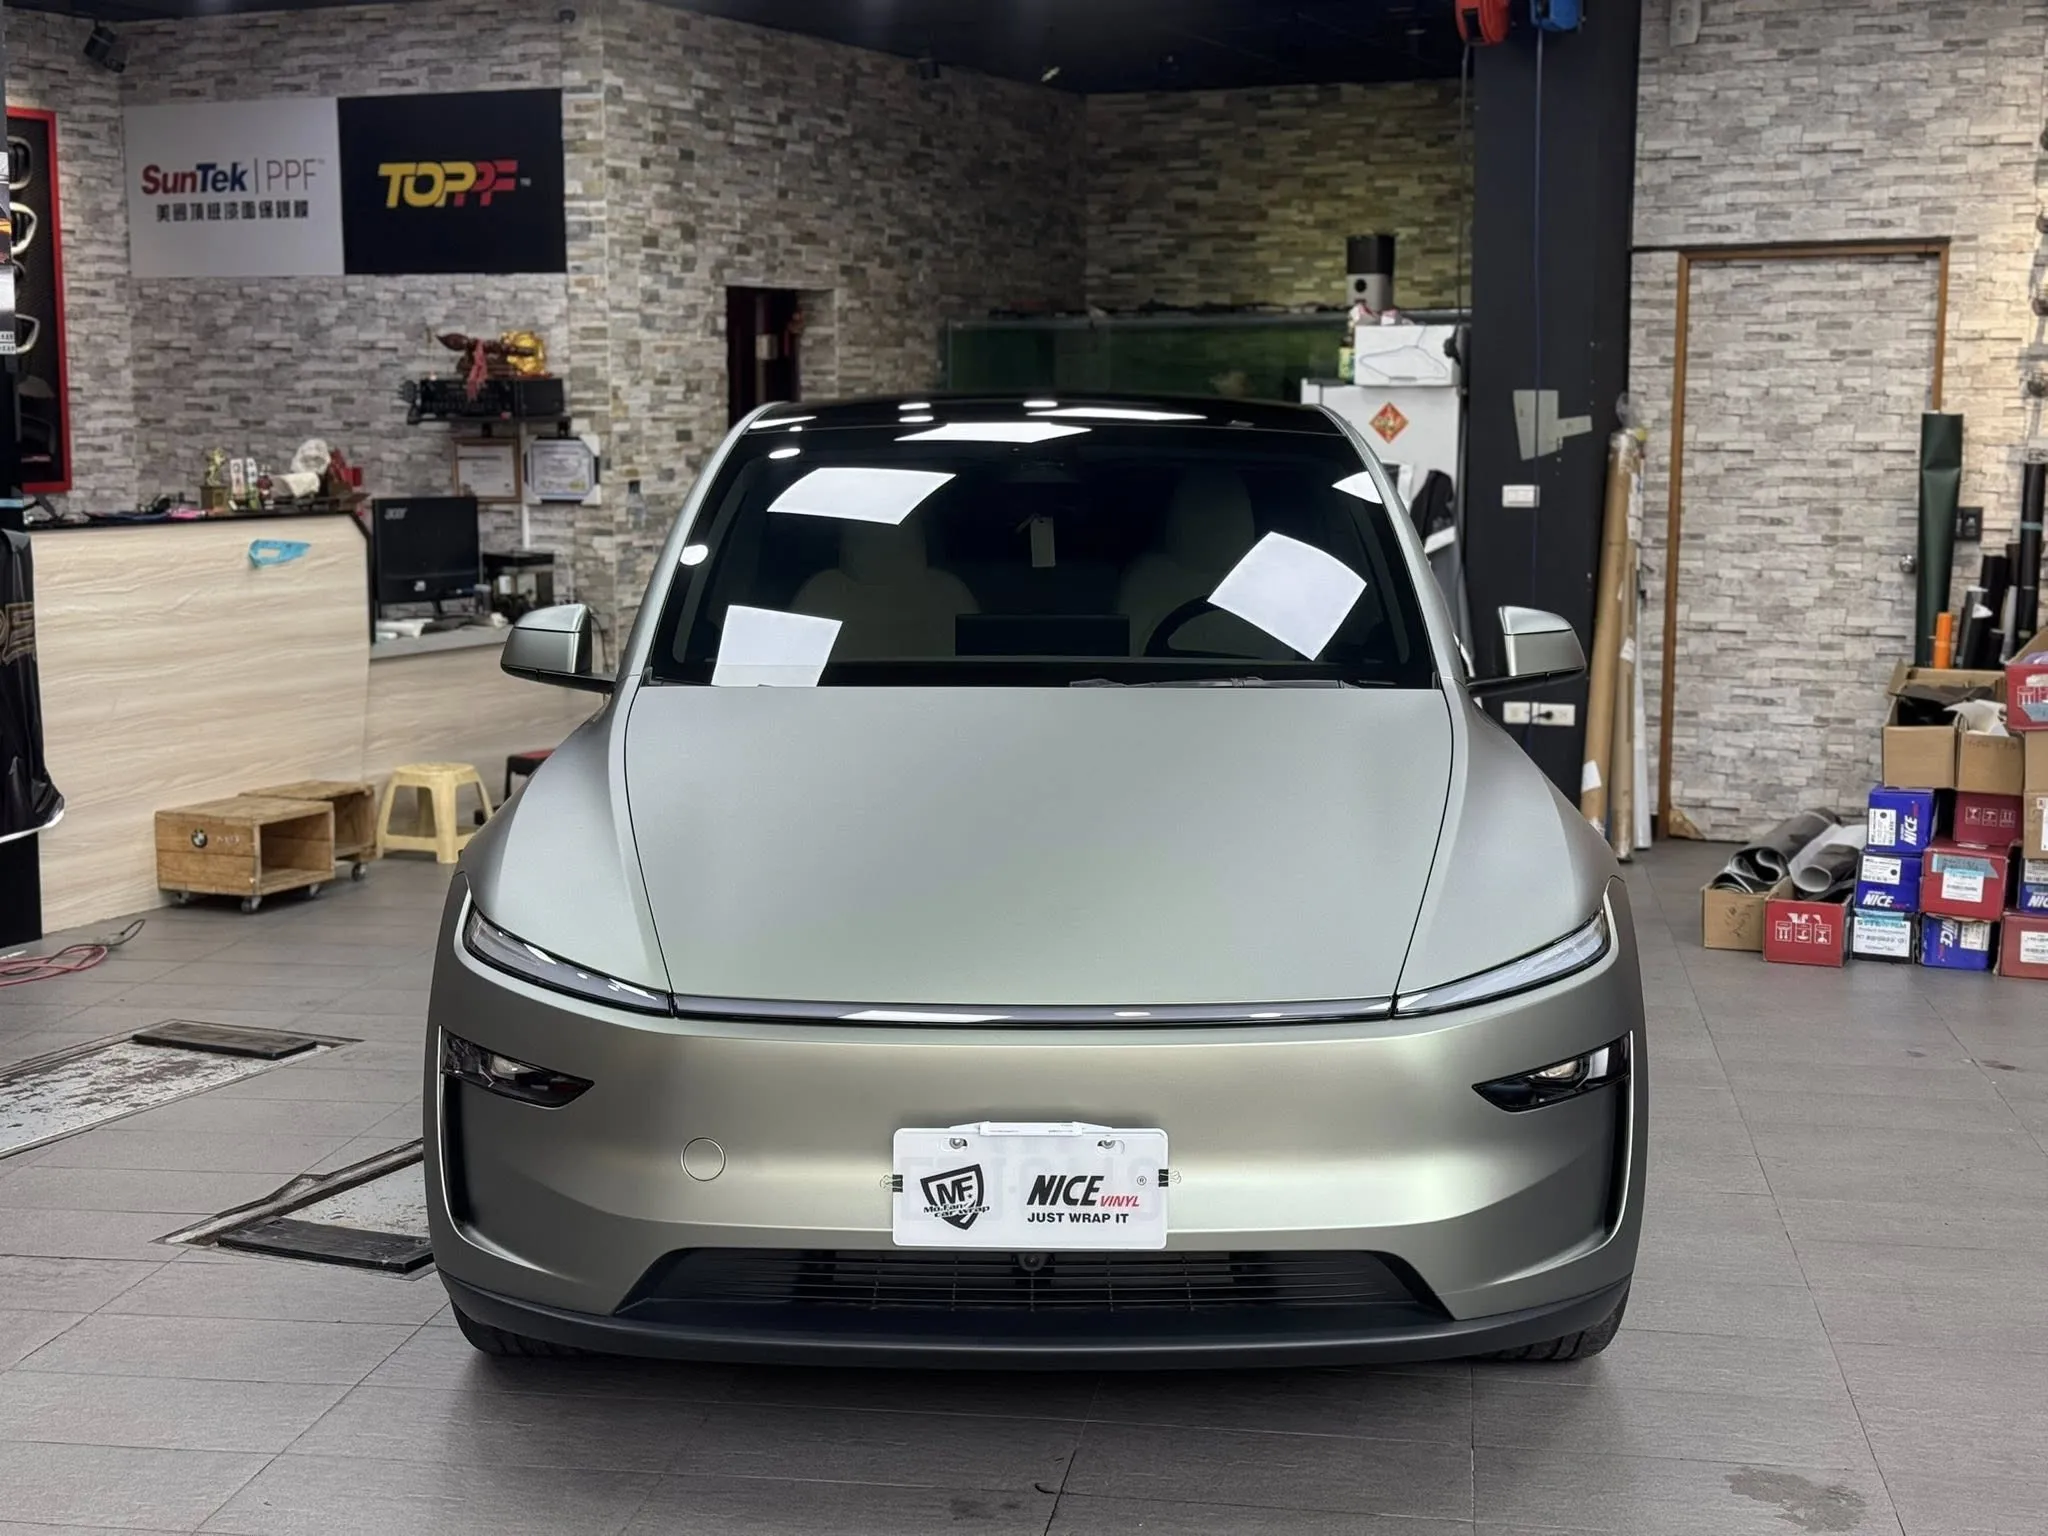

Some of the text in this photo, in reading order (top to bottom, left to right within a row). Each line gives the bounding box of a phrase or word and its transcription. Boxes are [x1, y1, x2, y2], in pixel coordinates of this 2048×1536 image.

[141, 158, 316, 195] SunTek PPF
[377, 159, 517, 209] TOPPF
[1904, 815, 1918, 846] NICE
[1862, 893, 1895, 908] NICE
[936, 1176, 973, 1206] MF
[1026, 1175, 1140, 1207] NICE VINYL
[1027, 1212, 1130, 1223] JUST WRAP IT
